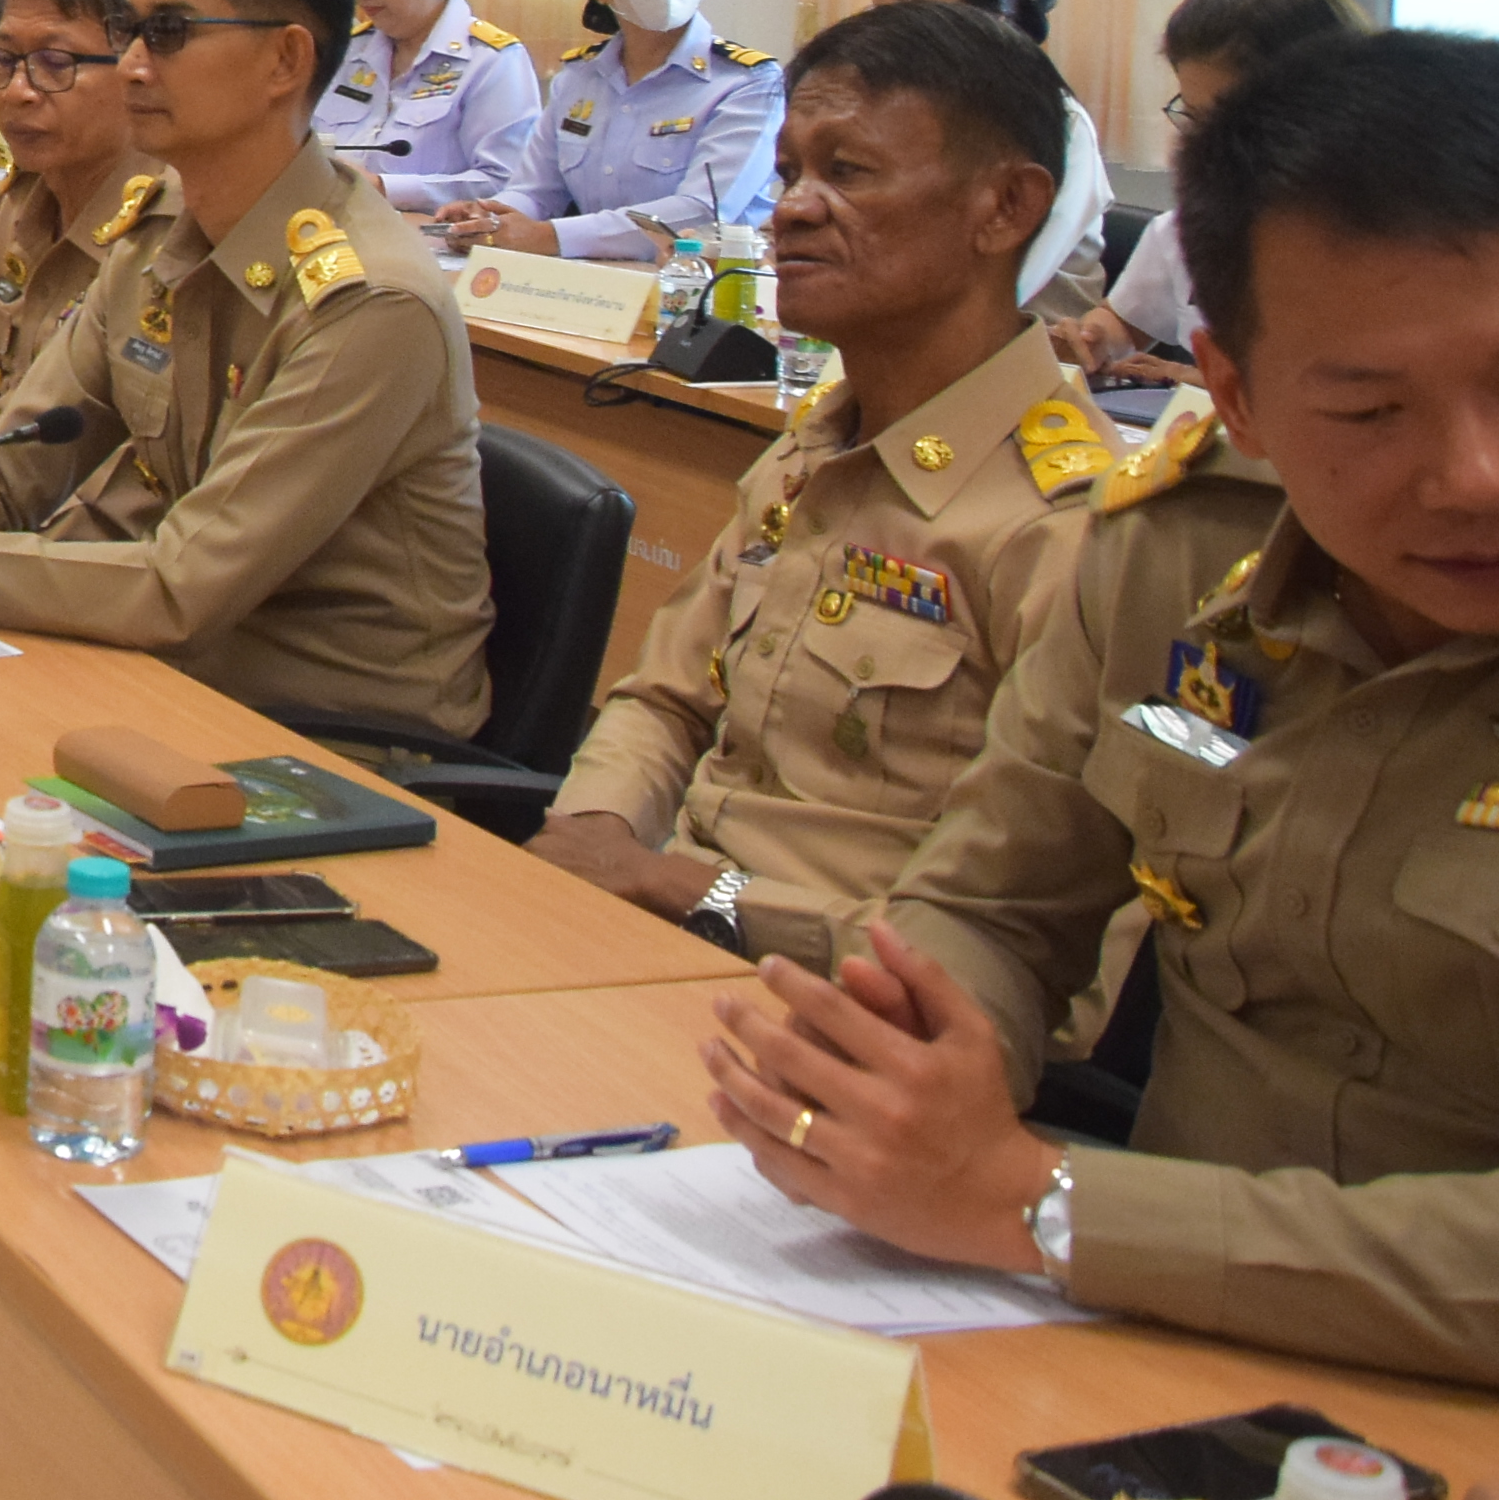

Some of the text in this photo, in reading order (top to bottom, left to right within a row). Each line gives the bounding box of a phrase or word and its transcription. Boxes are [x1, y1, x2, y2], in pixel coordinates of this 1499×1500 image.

[417, 1312, 714, 1430] นายอำเภอนาหมื่น
